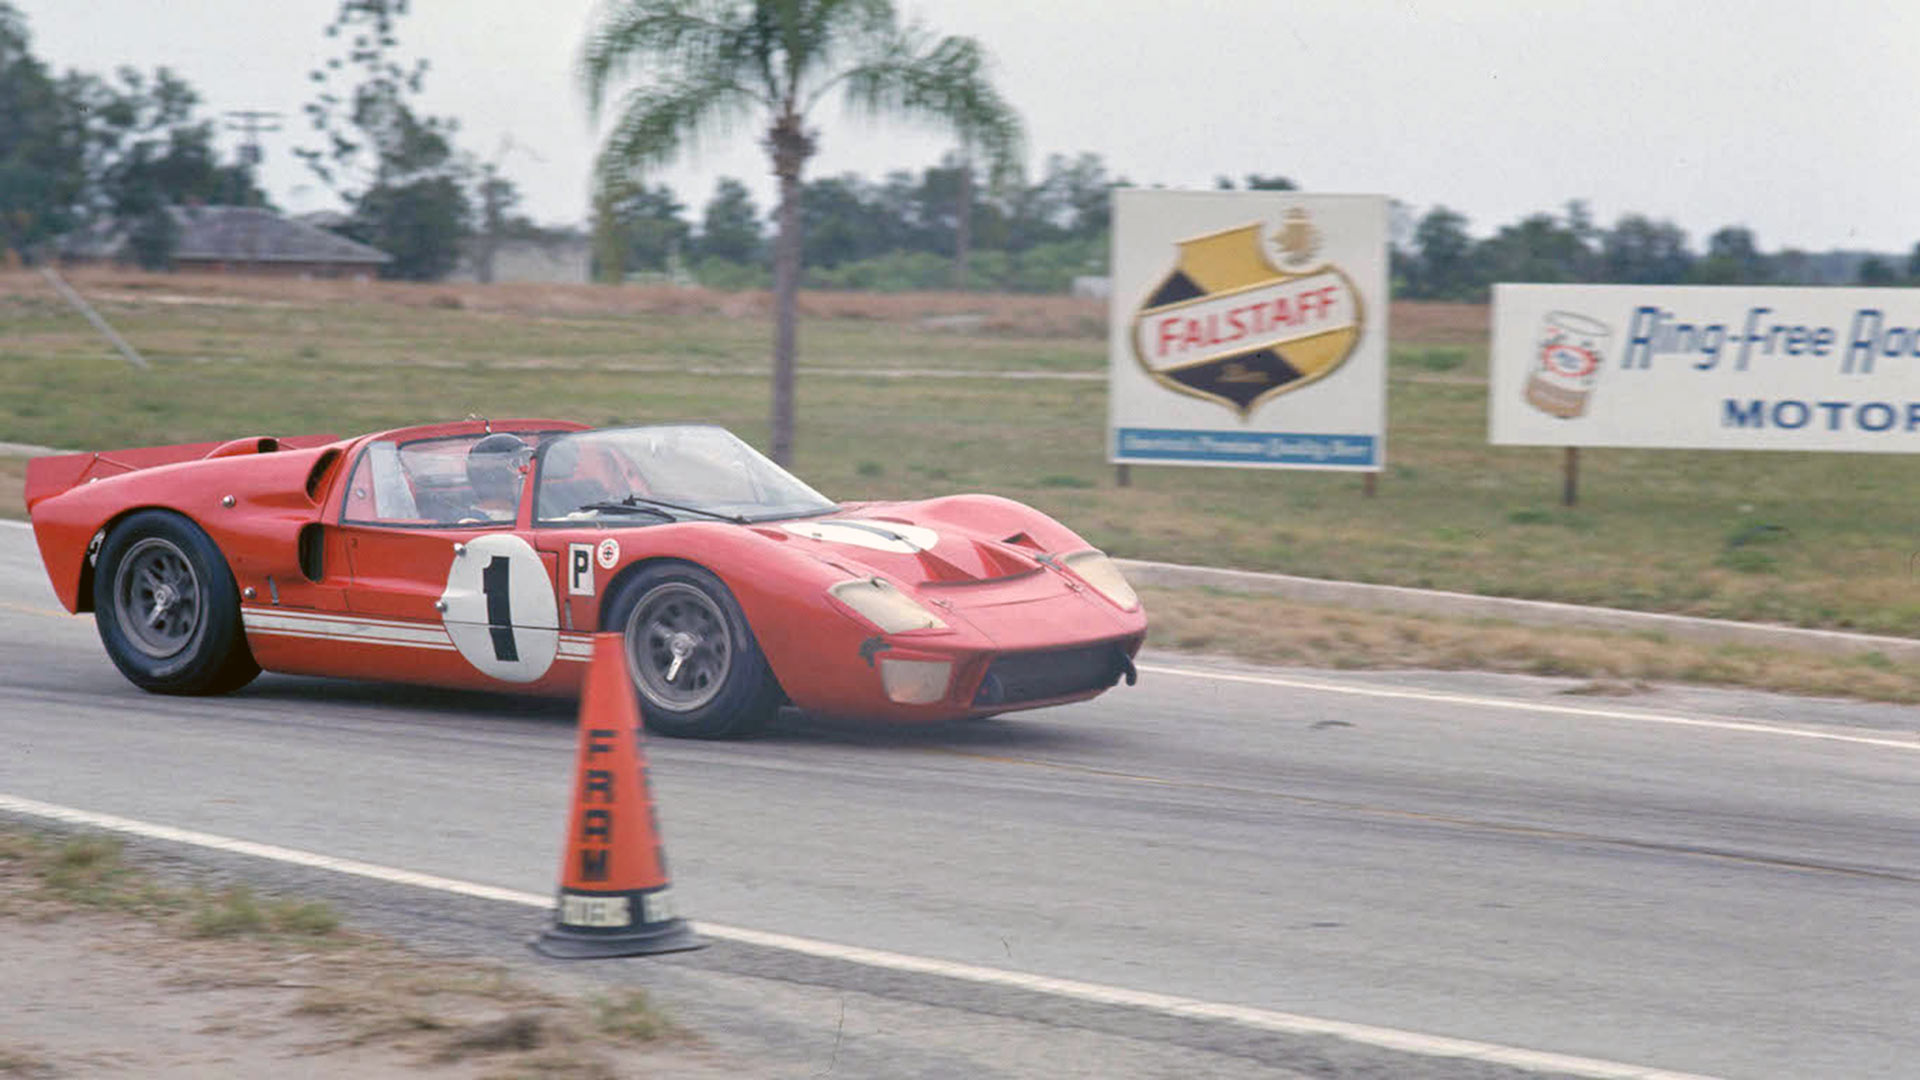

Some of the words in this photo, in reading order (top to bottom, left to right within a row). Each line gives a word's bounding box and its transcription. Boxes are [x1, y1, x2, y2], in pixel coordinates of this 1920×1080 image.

[1157, 286, 1339, 356] FALSTAFF
[1620, 306, 1836, 370] Ring-Free
[573, 549, 590, 589] P
[483, 556, 520, 662] 1
[579, 728, 618, 882] FRAM
